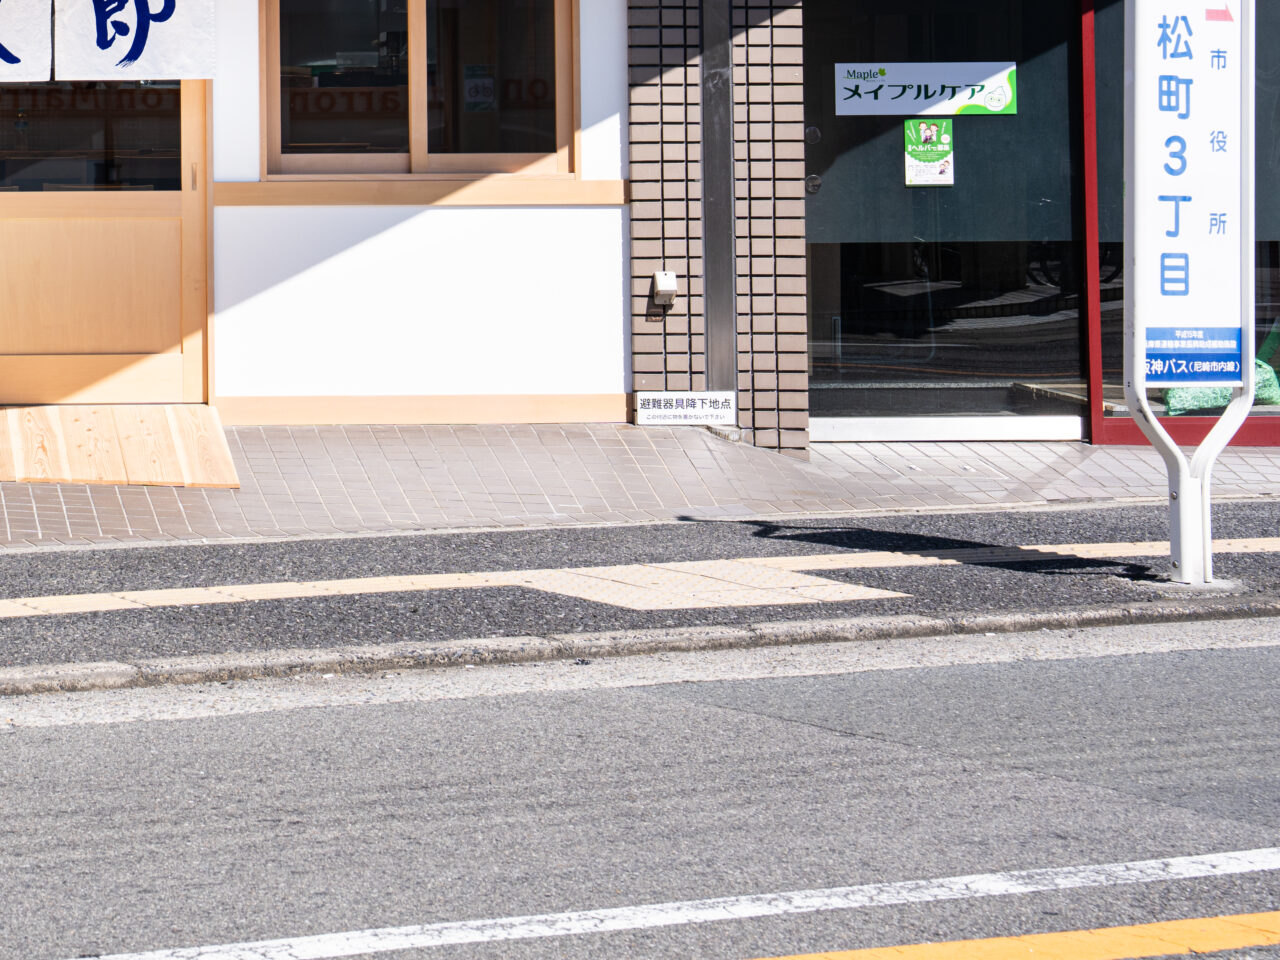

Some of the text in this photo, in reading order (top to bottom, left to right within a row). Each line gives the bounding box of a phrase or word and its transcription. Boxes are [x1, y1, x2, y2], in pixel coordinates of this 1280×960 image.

[846, 69, 878, 81] Maple
[843, 84, 985, 101] メイプルケア
[1209, 48, 1228, 235] 市役所
[640, 398, 732, 410] 避難器具降下地点
